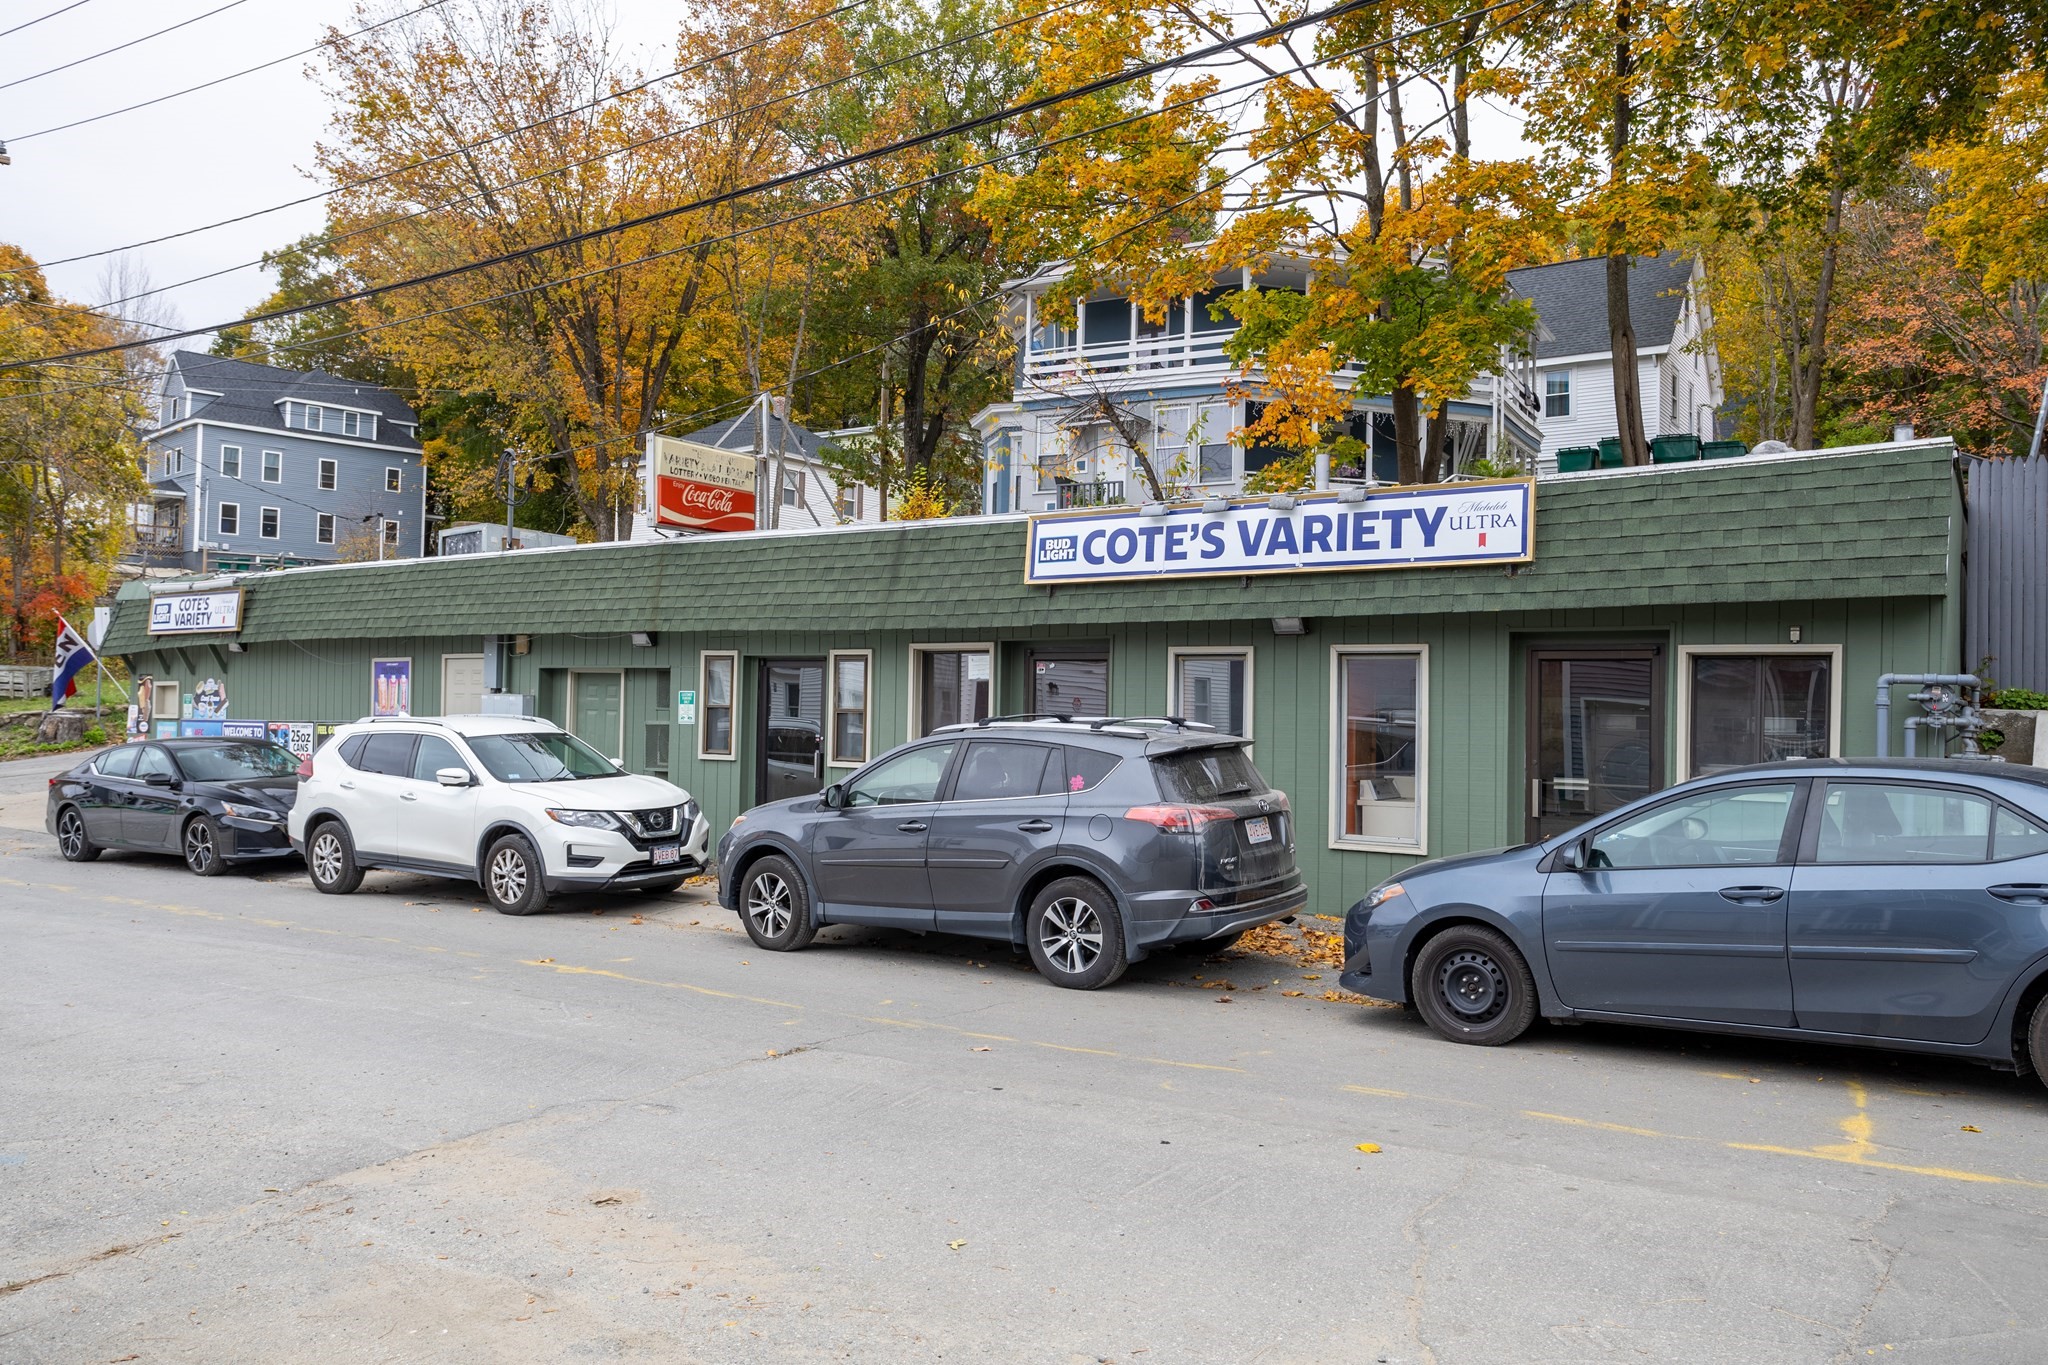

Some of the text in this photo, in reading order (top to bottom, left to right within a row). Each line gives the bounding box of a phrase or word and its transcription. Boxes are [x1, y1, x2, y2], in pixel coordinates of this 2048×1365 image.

[670, 466, 698, 478] LOTTERY
[672, 481, 685, 490] Enjoy
[1458, 500, 1508, 513] Michelob
[1450, 514, 1517, 530] ULTRA
[1082, 506, 1448, 564] COTE'S VARIETY
[1046, 538, 1070, 550] BUD
[1040, 549, 1075, 561] LIGHT
[179, 597, 210, 611] COTE'S
[175, 612, 212, 626] VARIETY
[224, 727, 262, 737] WELCOME TO
[293, 743, 309, 752] CANS
